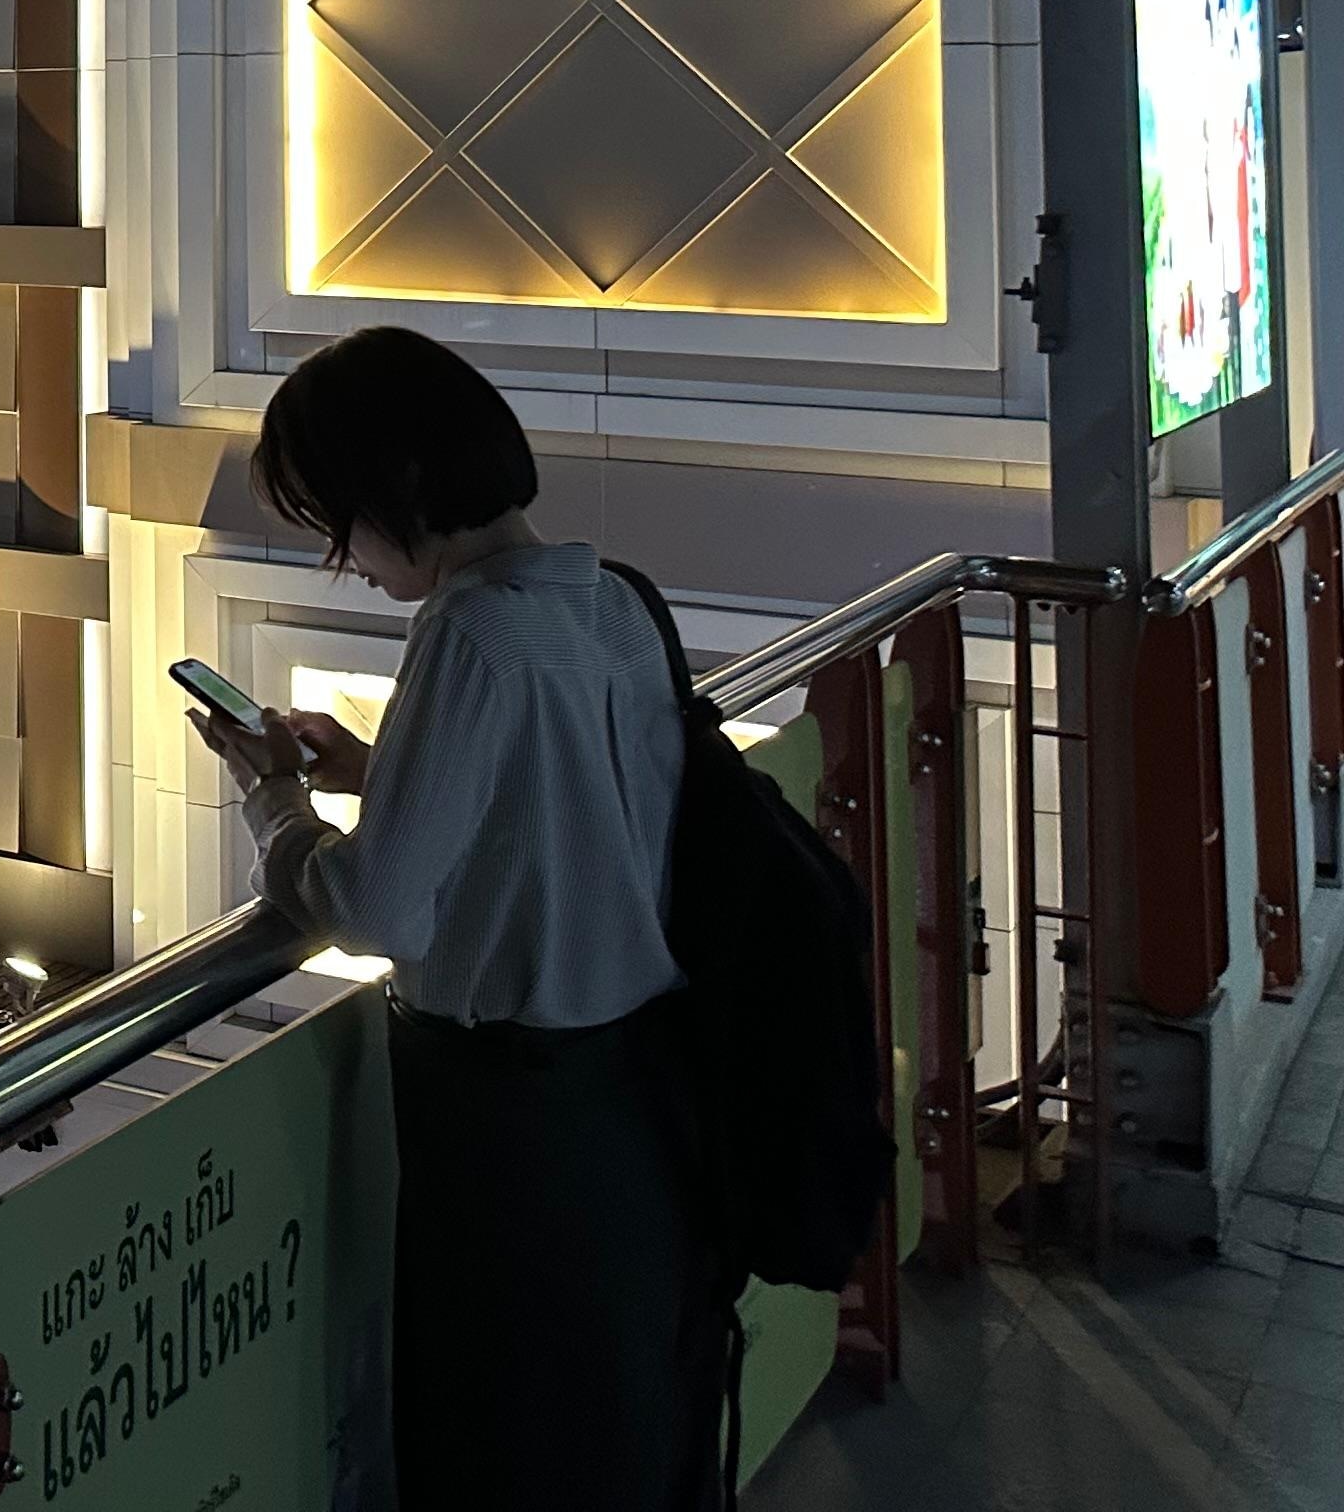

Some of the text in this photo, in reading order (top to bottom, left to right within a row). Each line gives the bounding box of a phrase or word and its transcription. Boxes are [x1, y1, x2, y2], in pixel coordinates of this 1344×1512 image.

[42, 1148, 235, 1345] แกะ ล้าง เก็บ
